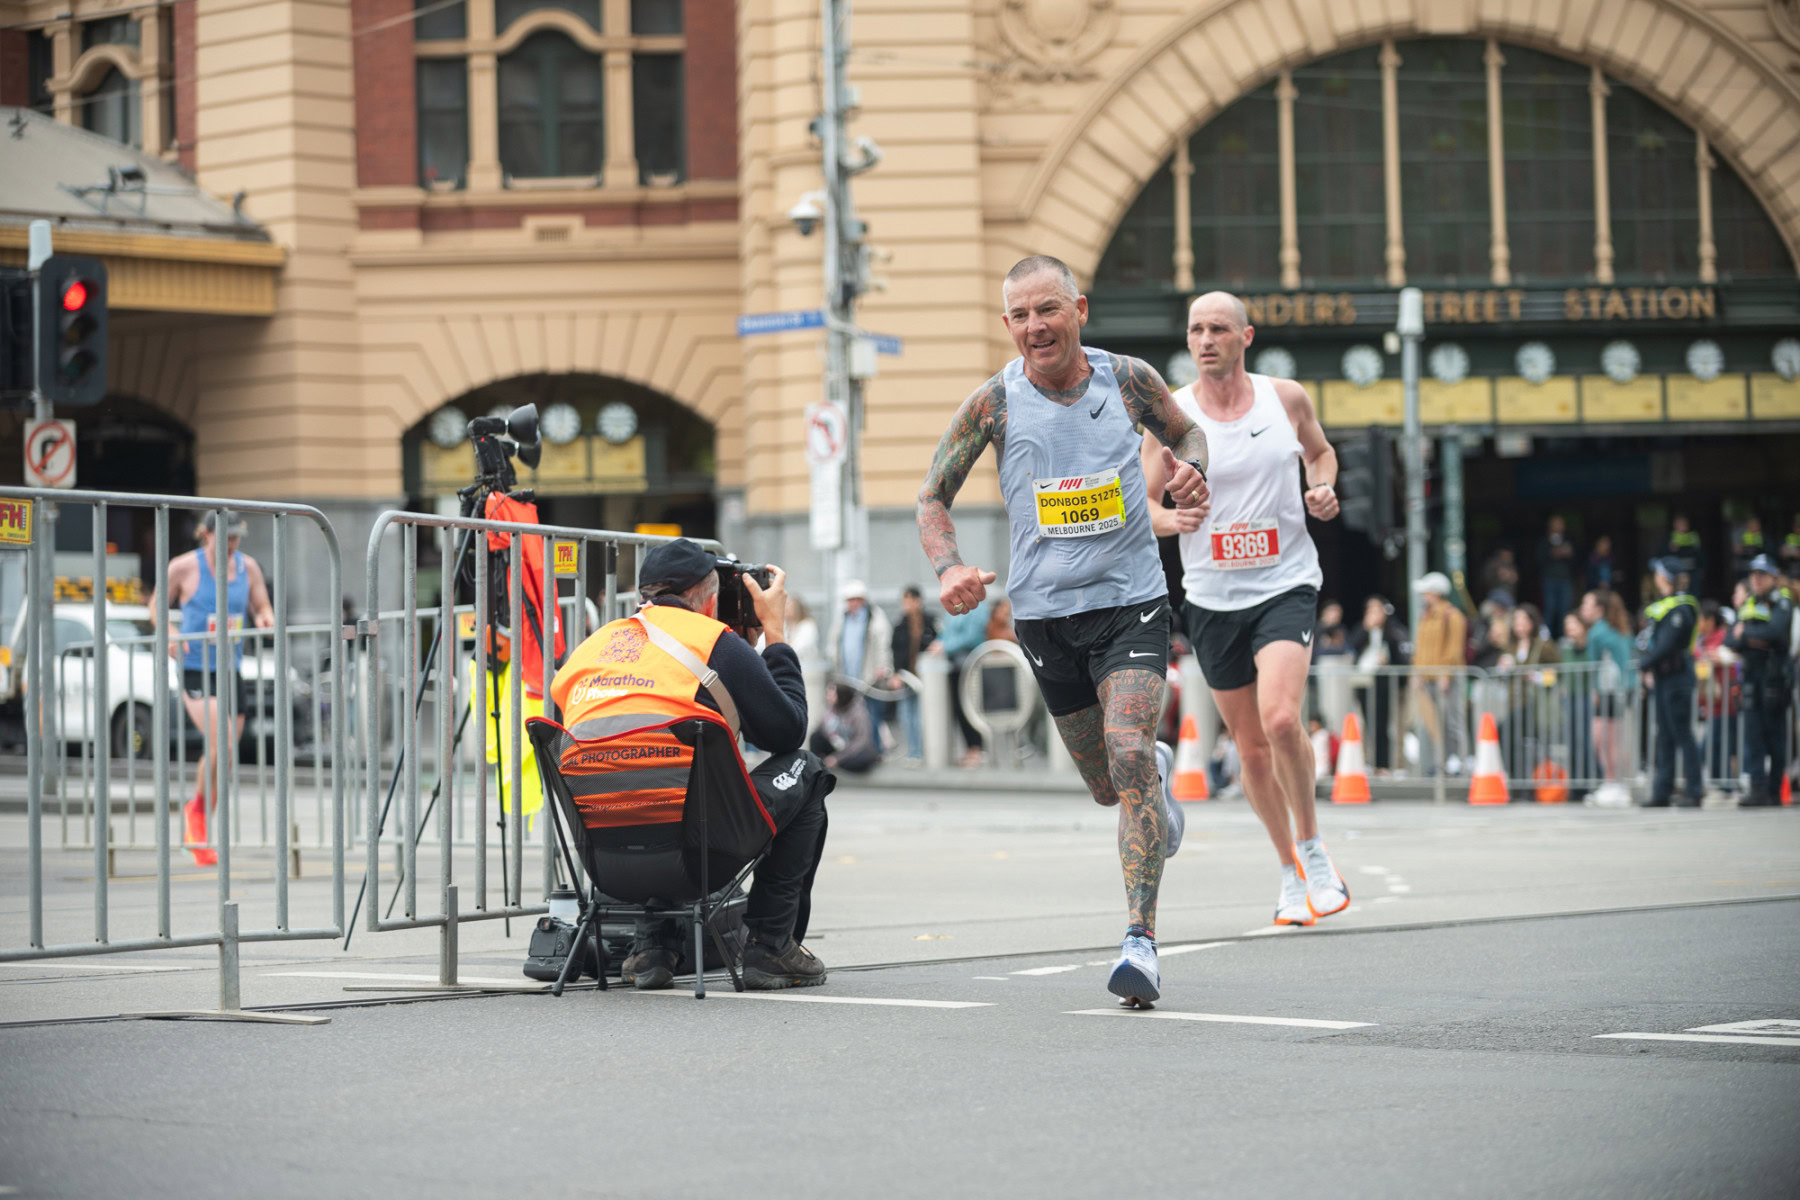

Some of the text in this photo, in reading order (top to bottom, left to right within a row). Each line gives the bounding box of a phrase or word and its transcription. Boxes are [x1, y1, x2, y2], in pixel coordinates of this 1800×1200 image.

[1240, 287, 1715, 326] NDERS TREET STATION
[1041, 487, 1121, 507] DONBOB S1275
[0, 503, 22, 528] FH
[1061, 508, 1100, 524] 1069
[1048, 518, 1119, 535] MELBOURNE 2025
[1222, 532, 1270, 559] 9369
[589, 674, 655, 689] Marathon
[581, 746, 681, 765] PHOTOGRAPHER
